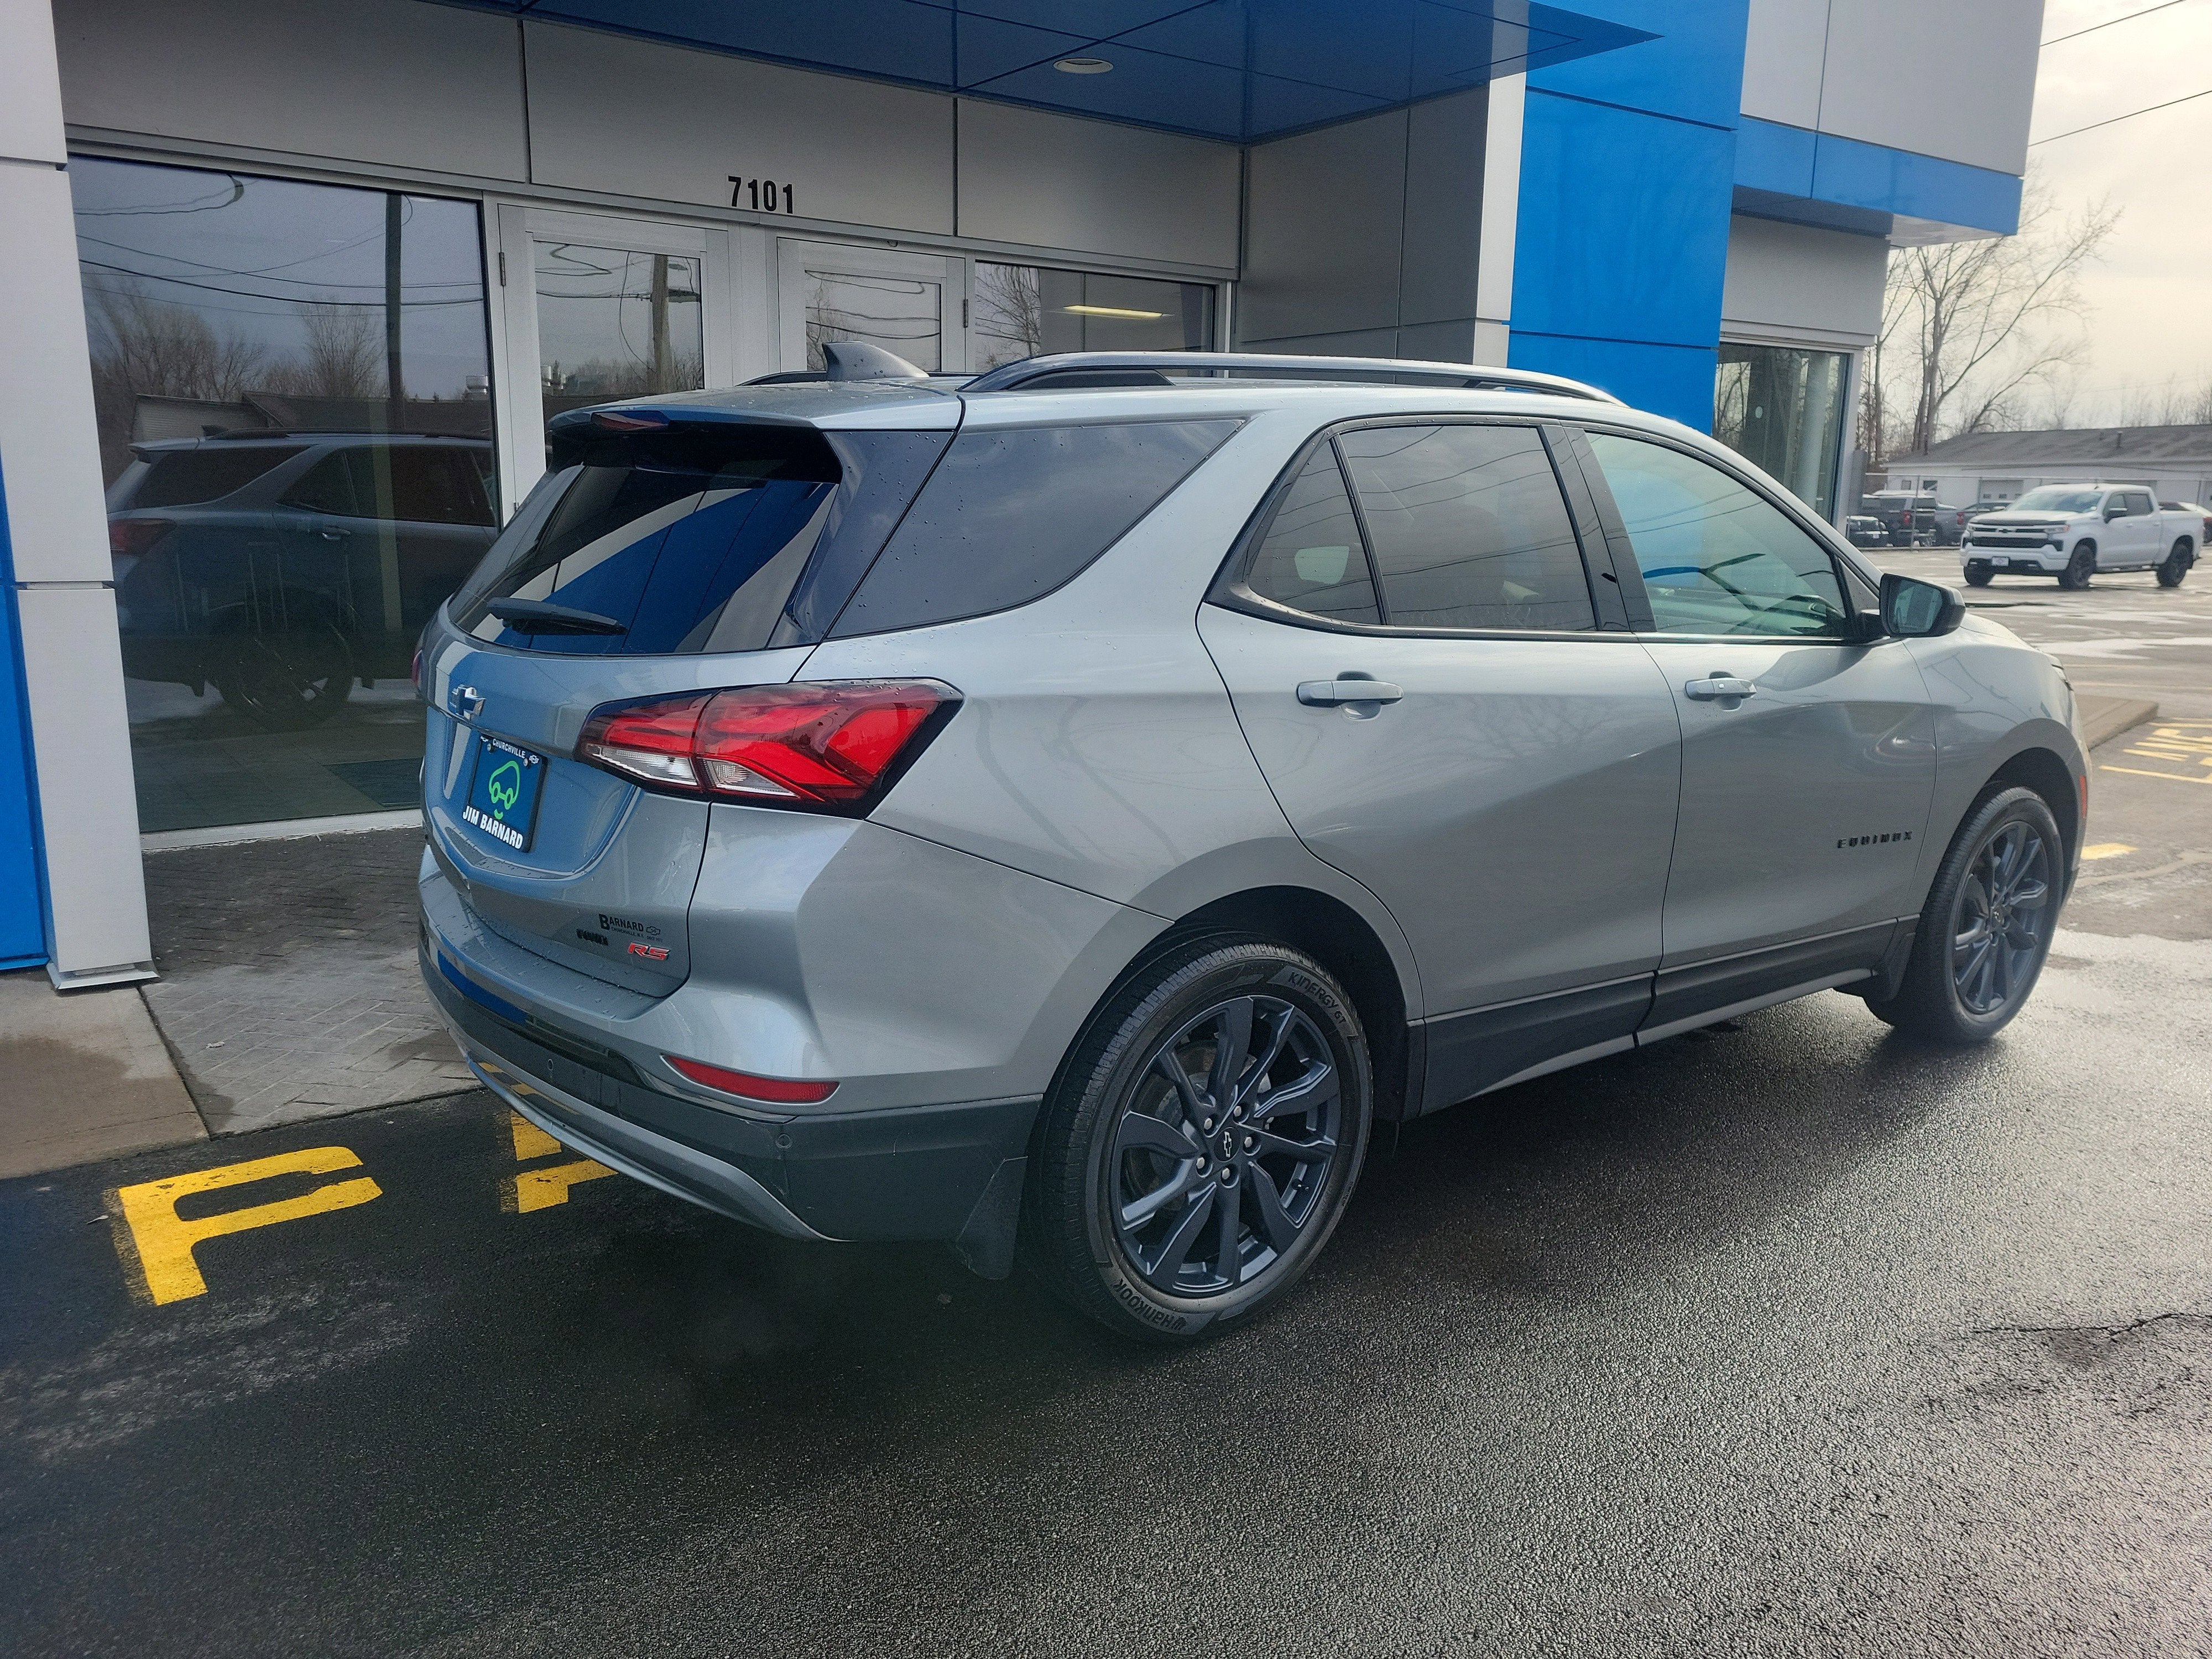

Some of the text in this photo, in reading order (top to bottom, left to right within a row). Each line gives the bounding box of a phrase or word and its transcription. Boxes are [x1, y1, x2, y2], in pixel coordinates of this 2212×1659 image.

[728, 175, 793, 214] 7101
[492, 738, 525, 759] CHURCHVILLE
[462, 805, 524, 849] JIM BARNARD
[598, 914, 644, 932] BARNARD
[628, 941, 671, 961] RS
[1288, 972, 1347, 1024] KINERGY GT
